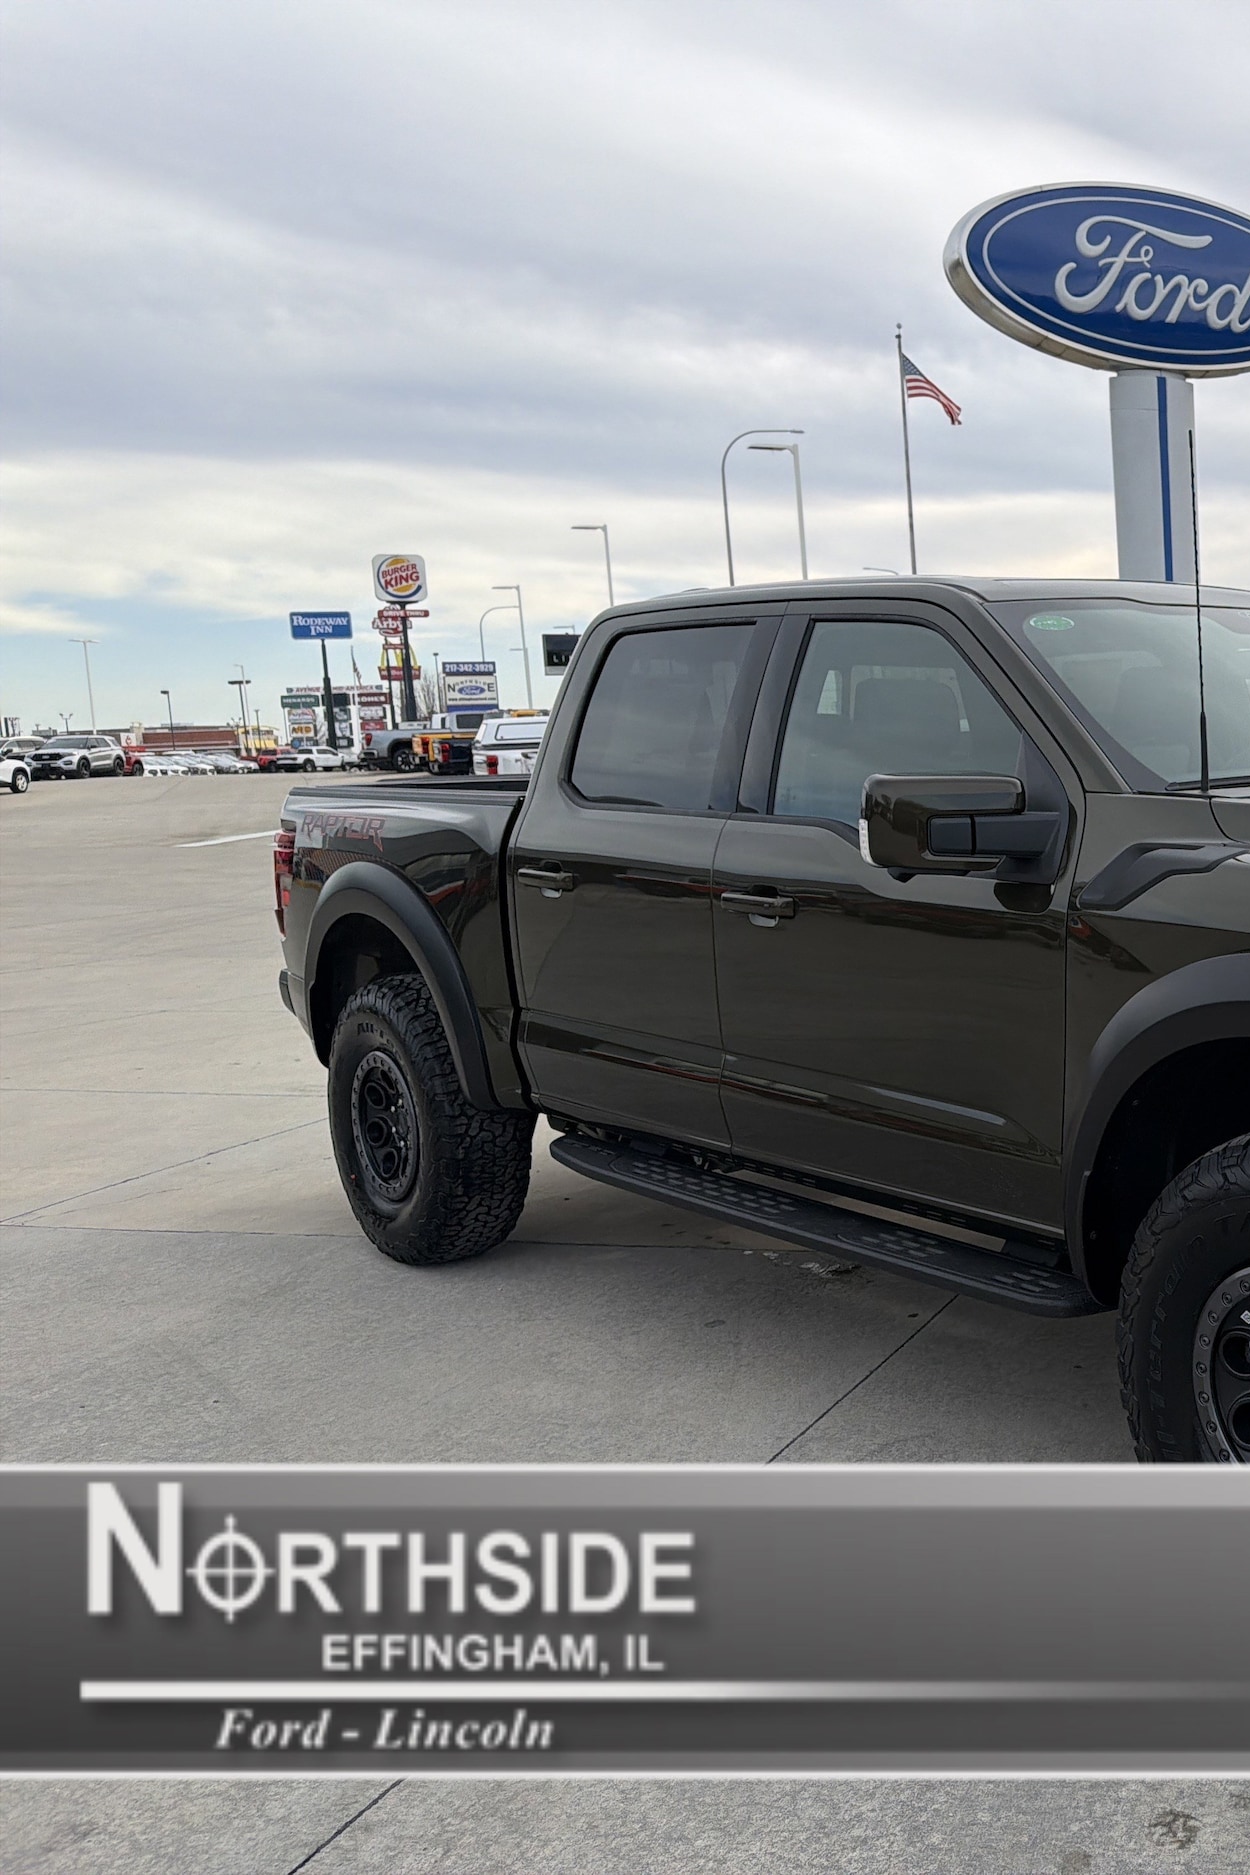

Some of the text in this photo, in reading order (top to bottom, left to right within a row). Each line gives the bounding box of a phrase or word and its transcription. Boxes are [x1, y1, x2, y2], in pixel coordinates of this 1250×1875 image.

[381, 563, 418, 579] BURGER
[384, 571, 420, 591] KING
[292, 615, 348, 627] RODEWAY
[310, 625, 333, 636] INN
[444, 663, 494, 672] 217-342-3929
[301, 813, 386, 852] RAPTOR
